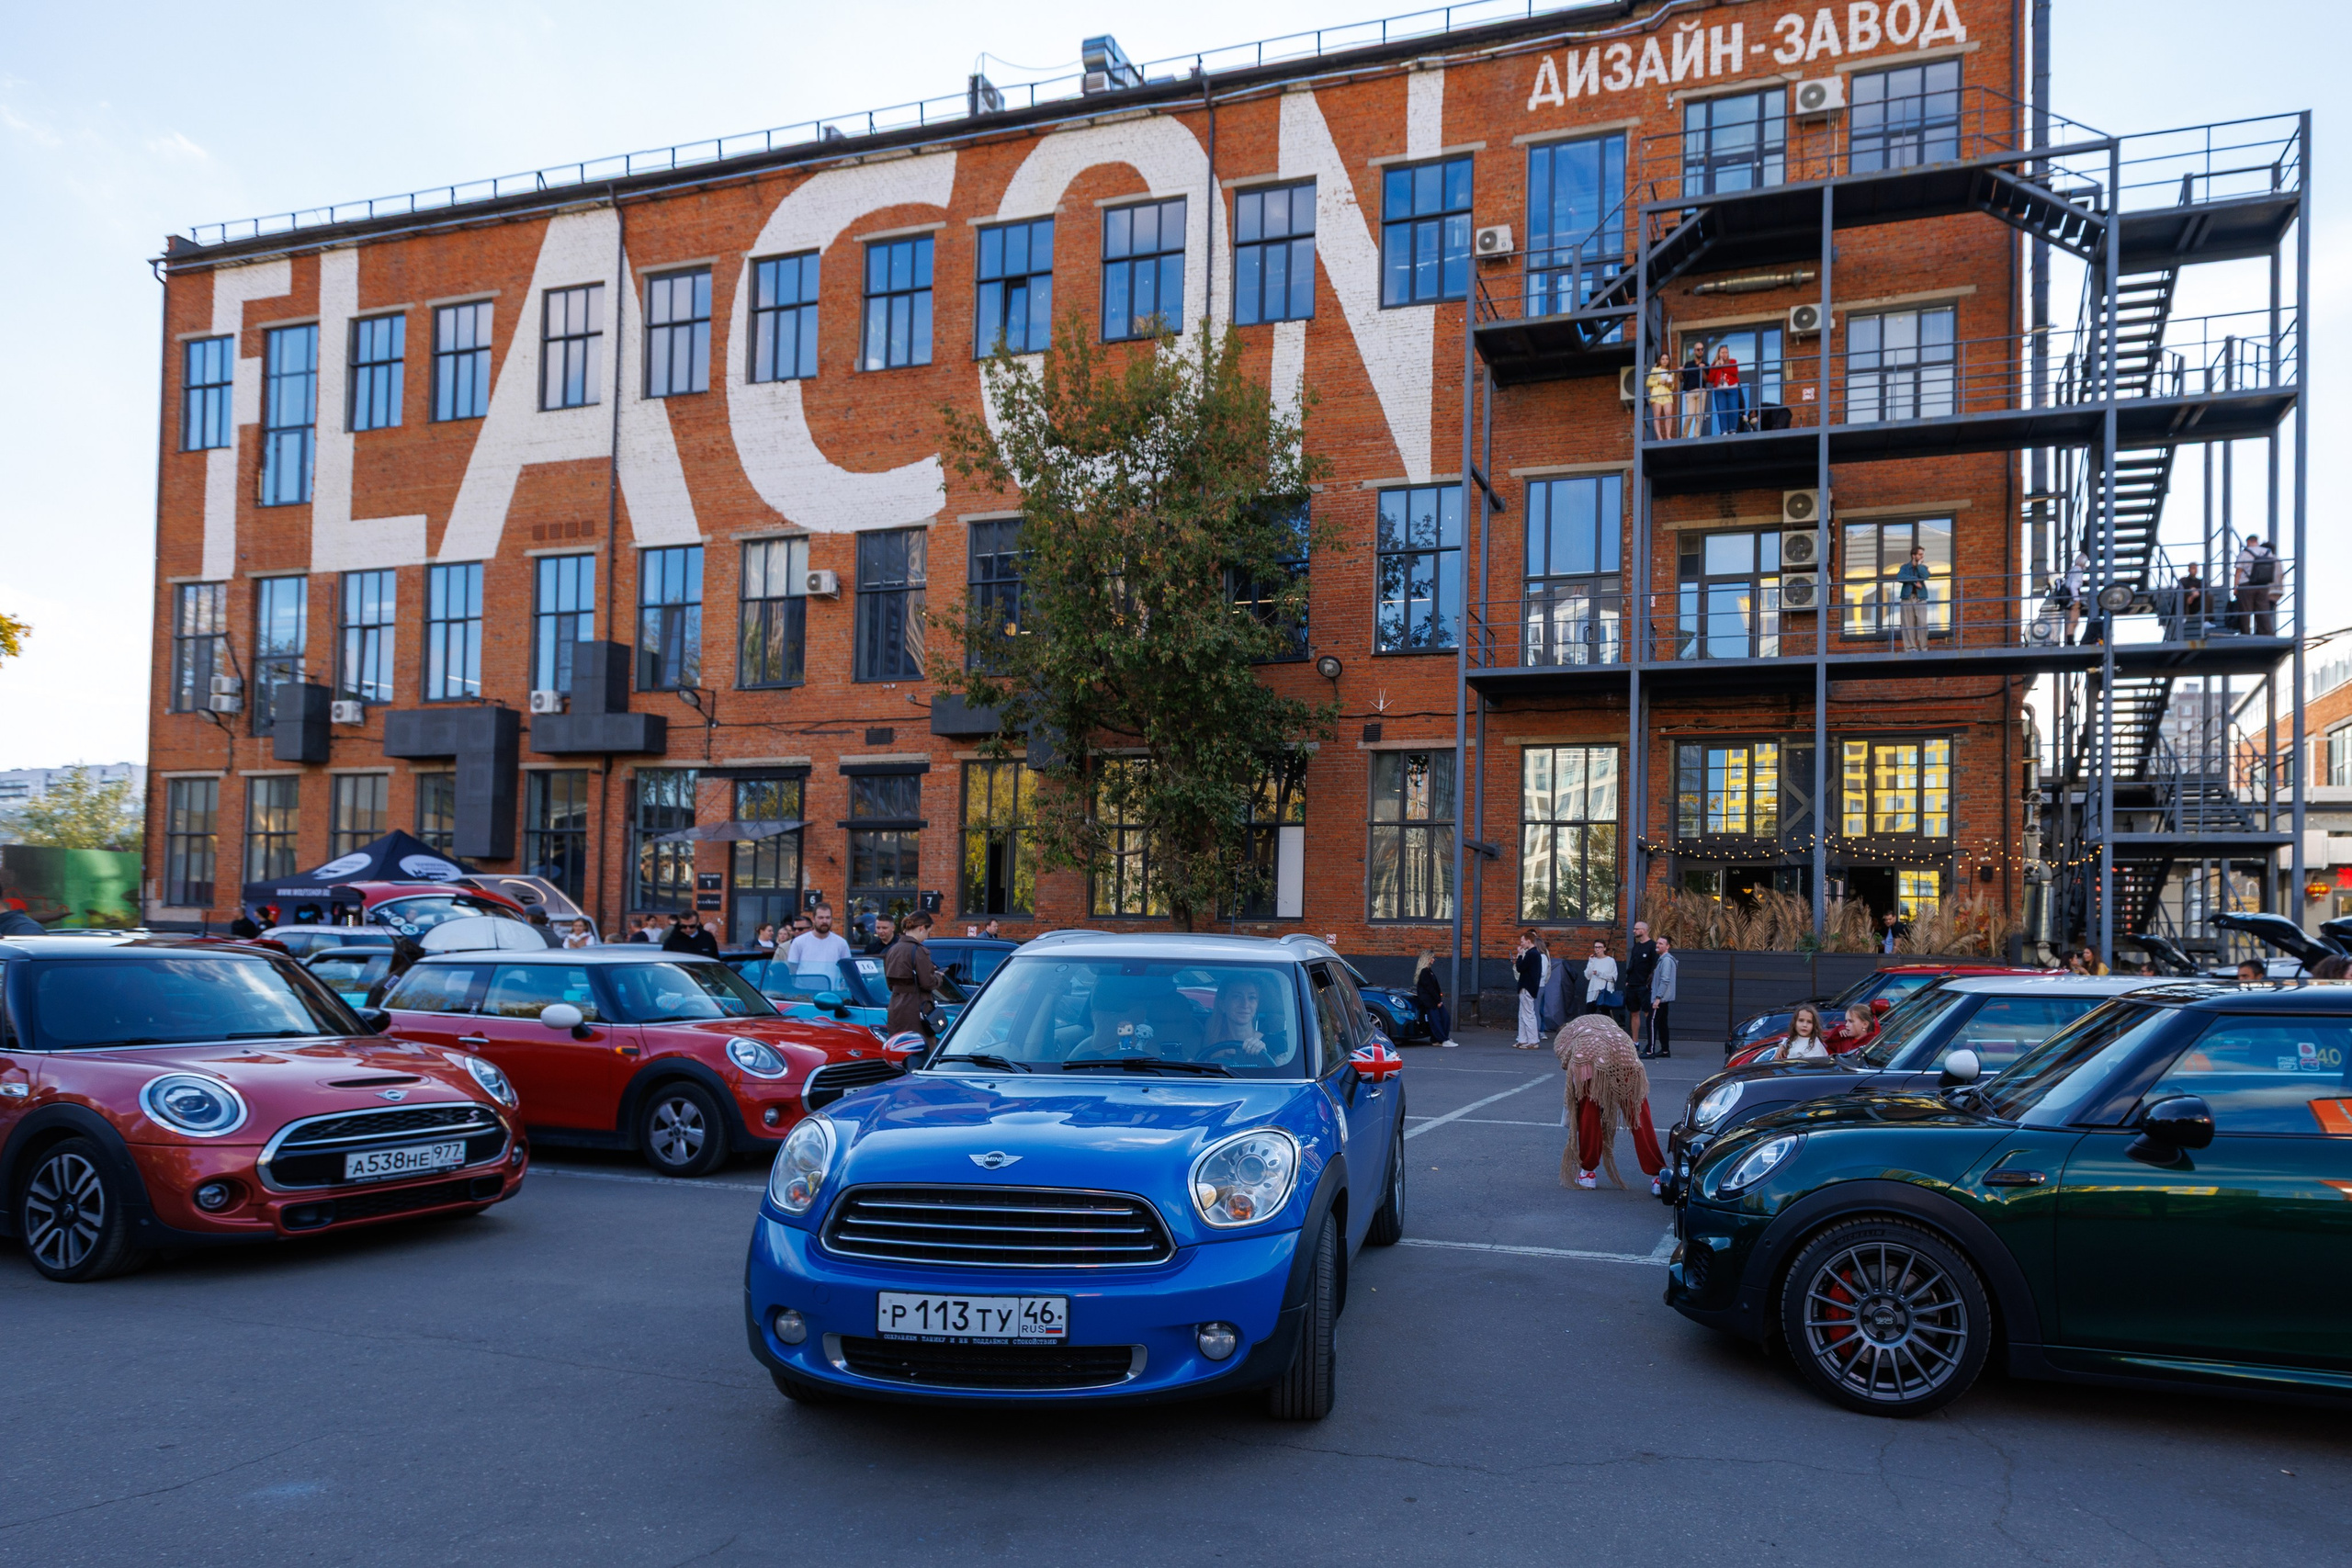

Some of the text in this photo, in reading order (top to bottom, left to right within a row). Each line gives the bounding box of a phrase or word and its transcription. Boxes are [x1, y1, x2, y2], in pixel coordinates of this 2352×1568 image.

[1527, 0, 1967, 111] ДИЗАЙН-ЗАВОД
[202, 68, 1445, 581] FLACON
[809, 895, 816, 905] 6
[927, 897, 933, 906] 7
[2316, 1048, 2342, 1066] 40
[434, 1144, 461, 1159] 977
[1023, 1301, 1055, 1325] 46
[1022, 1325, 1045, 1334] RUS
